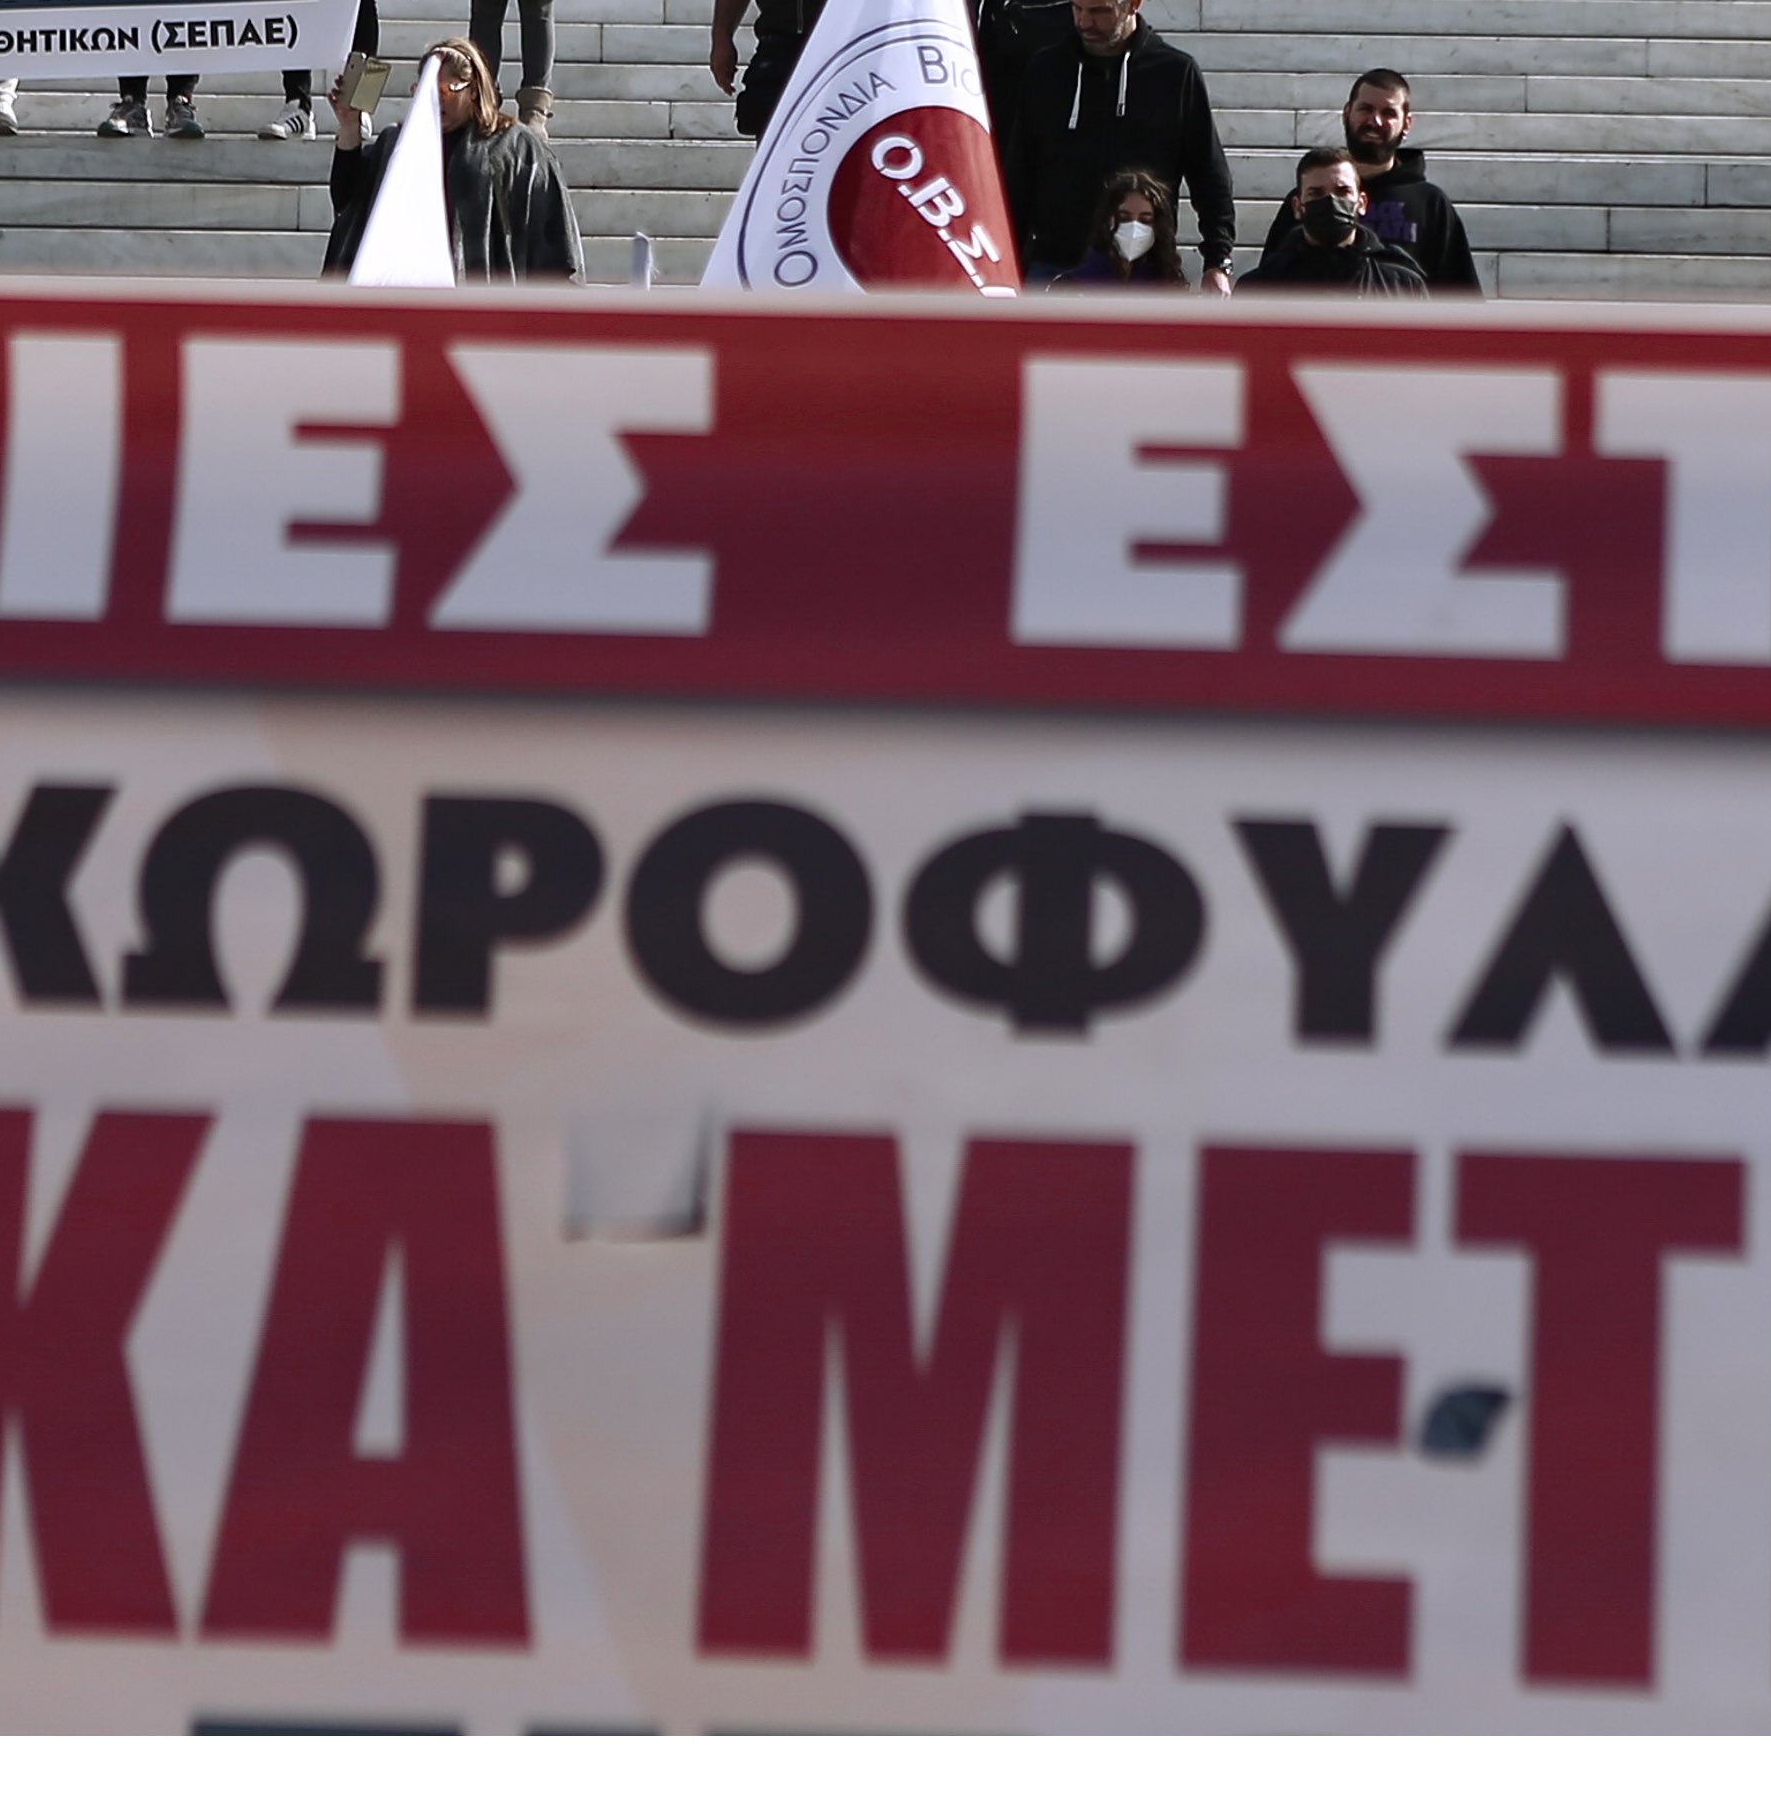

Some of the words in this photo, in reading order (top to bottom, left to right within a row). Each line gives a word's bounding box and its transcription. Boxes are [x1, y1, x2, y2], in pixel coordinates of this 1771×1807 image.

[151, 14, 299, 55] (ΣΕΠΑΕ)
[773, 70, 897, 288] ΟΜΟΣΠΟΝΔΙΑ
[870, 135, 1019, 297] Ο.Β.Σ.
